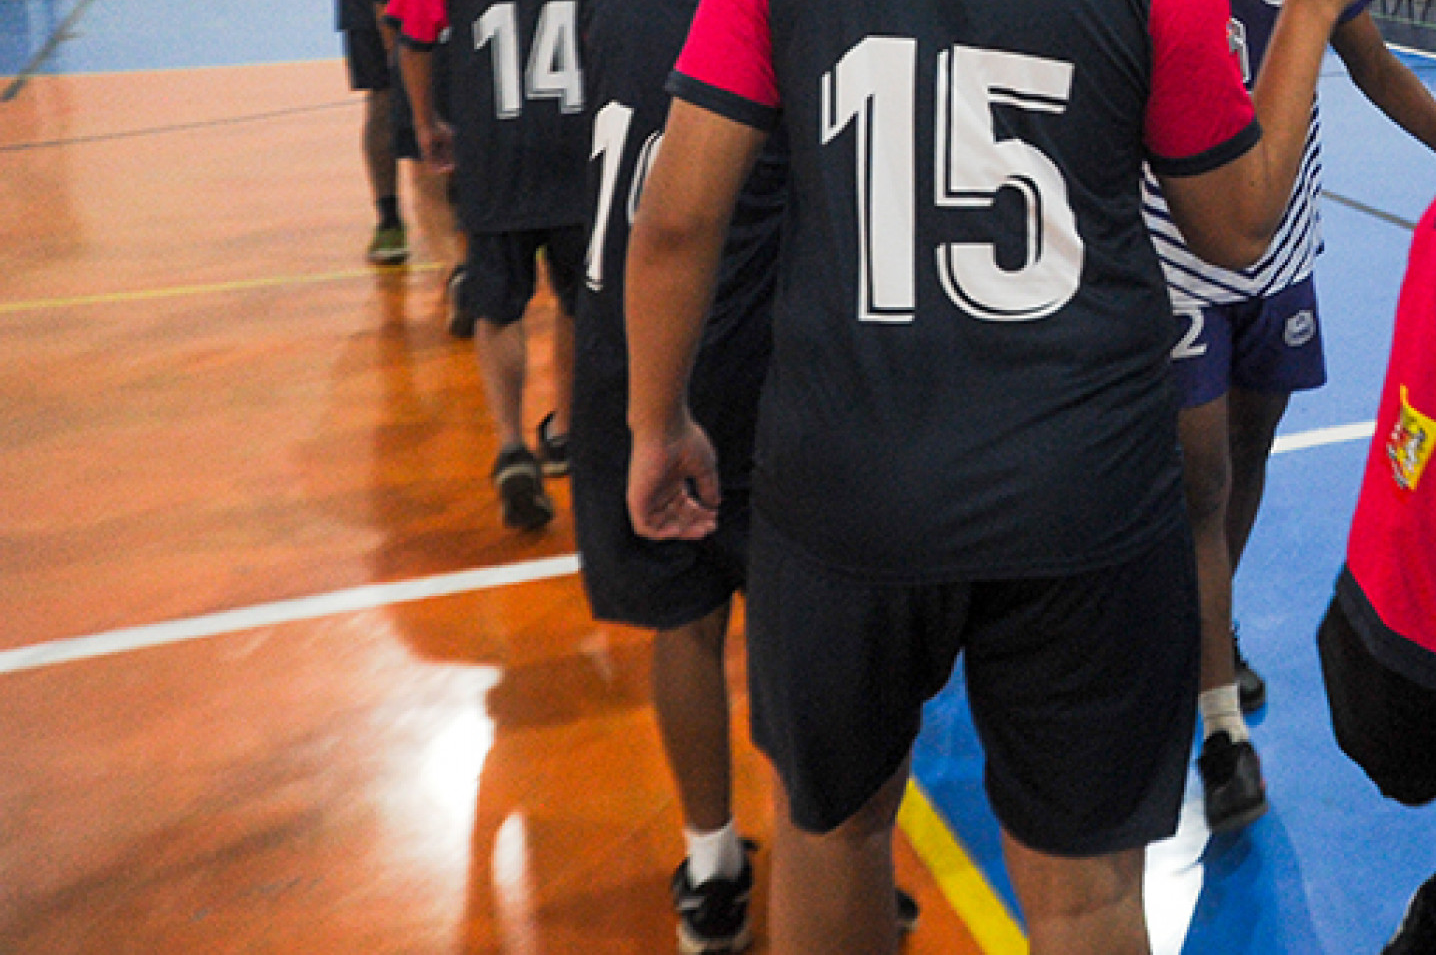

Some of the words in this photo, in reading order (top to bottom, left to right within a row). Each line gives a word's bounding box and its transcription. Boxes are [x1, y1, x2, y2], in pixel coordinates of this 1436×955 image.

[472, 0, 584, 119] 14
[585, 101, 665, 290] 1
[821, 35, 1084, 323] 15
